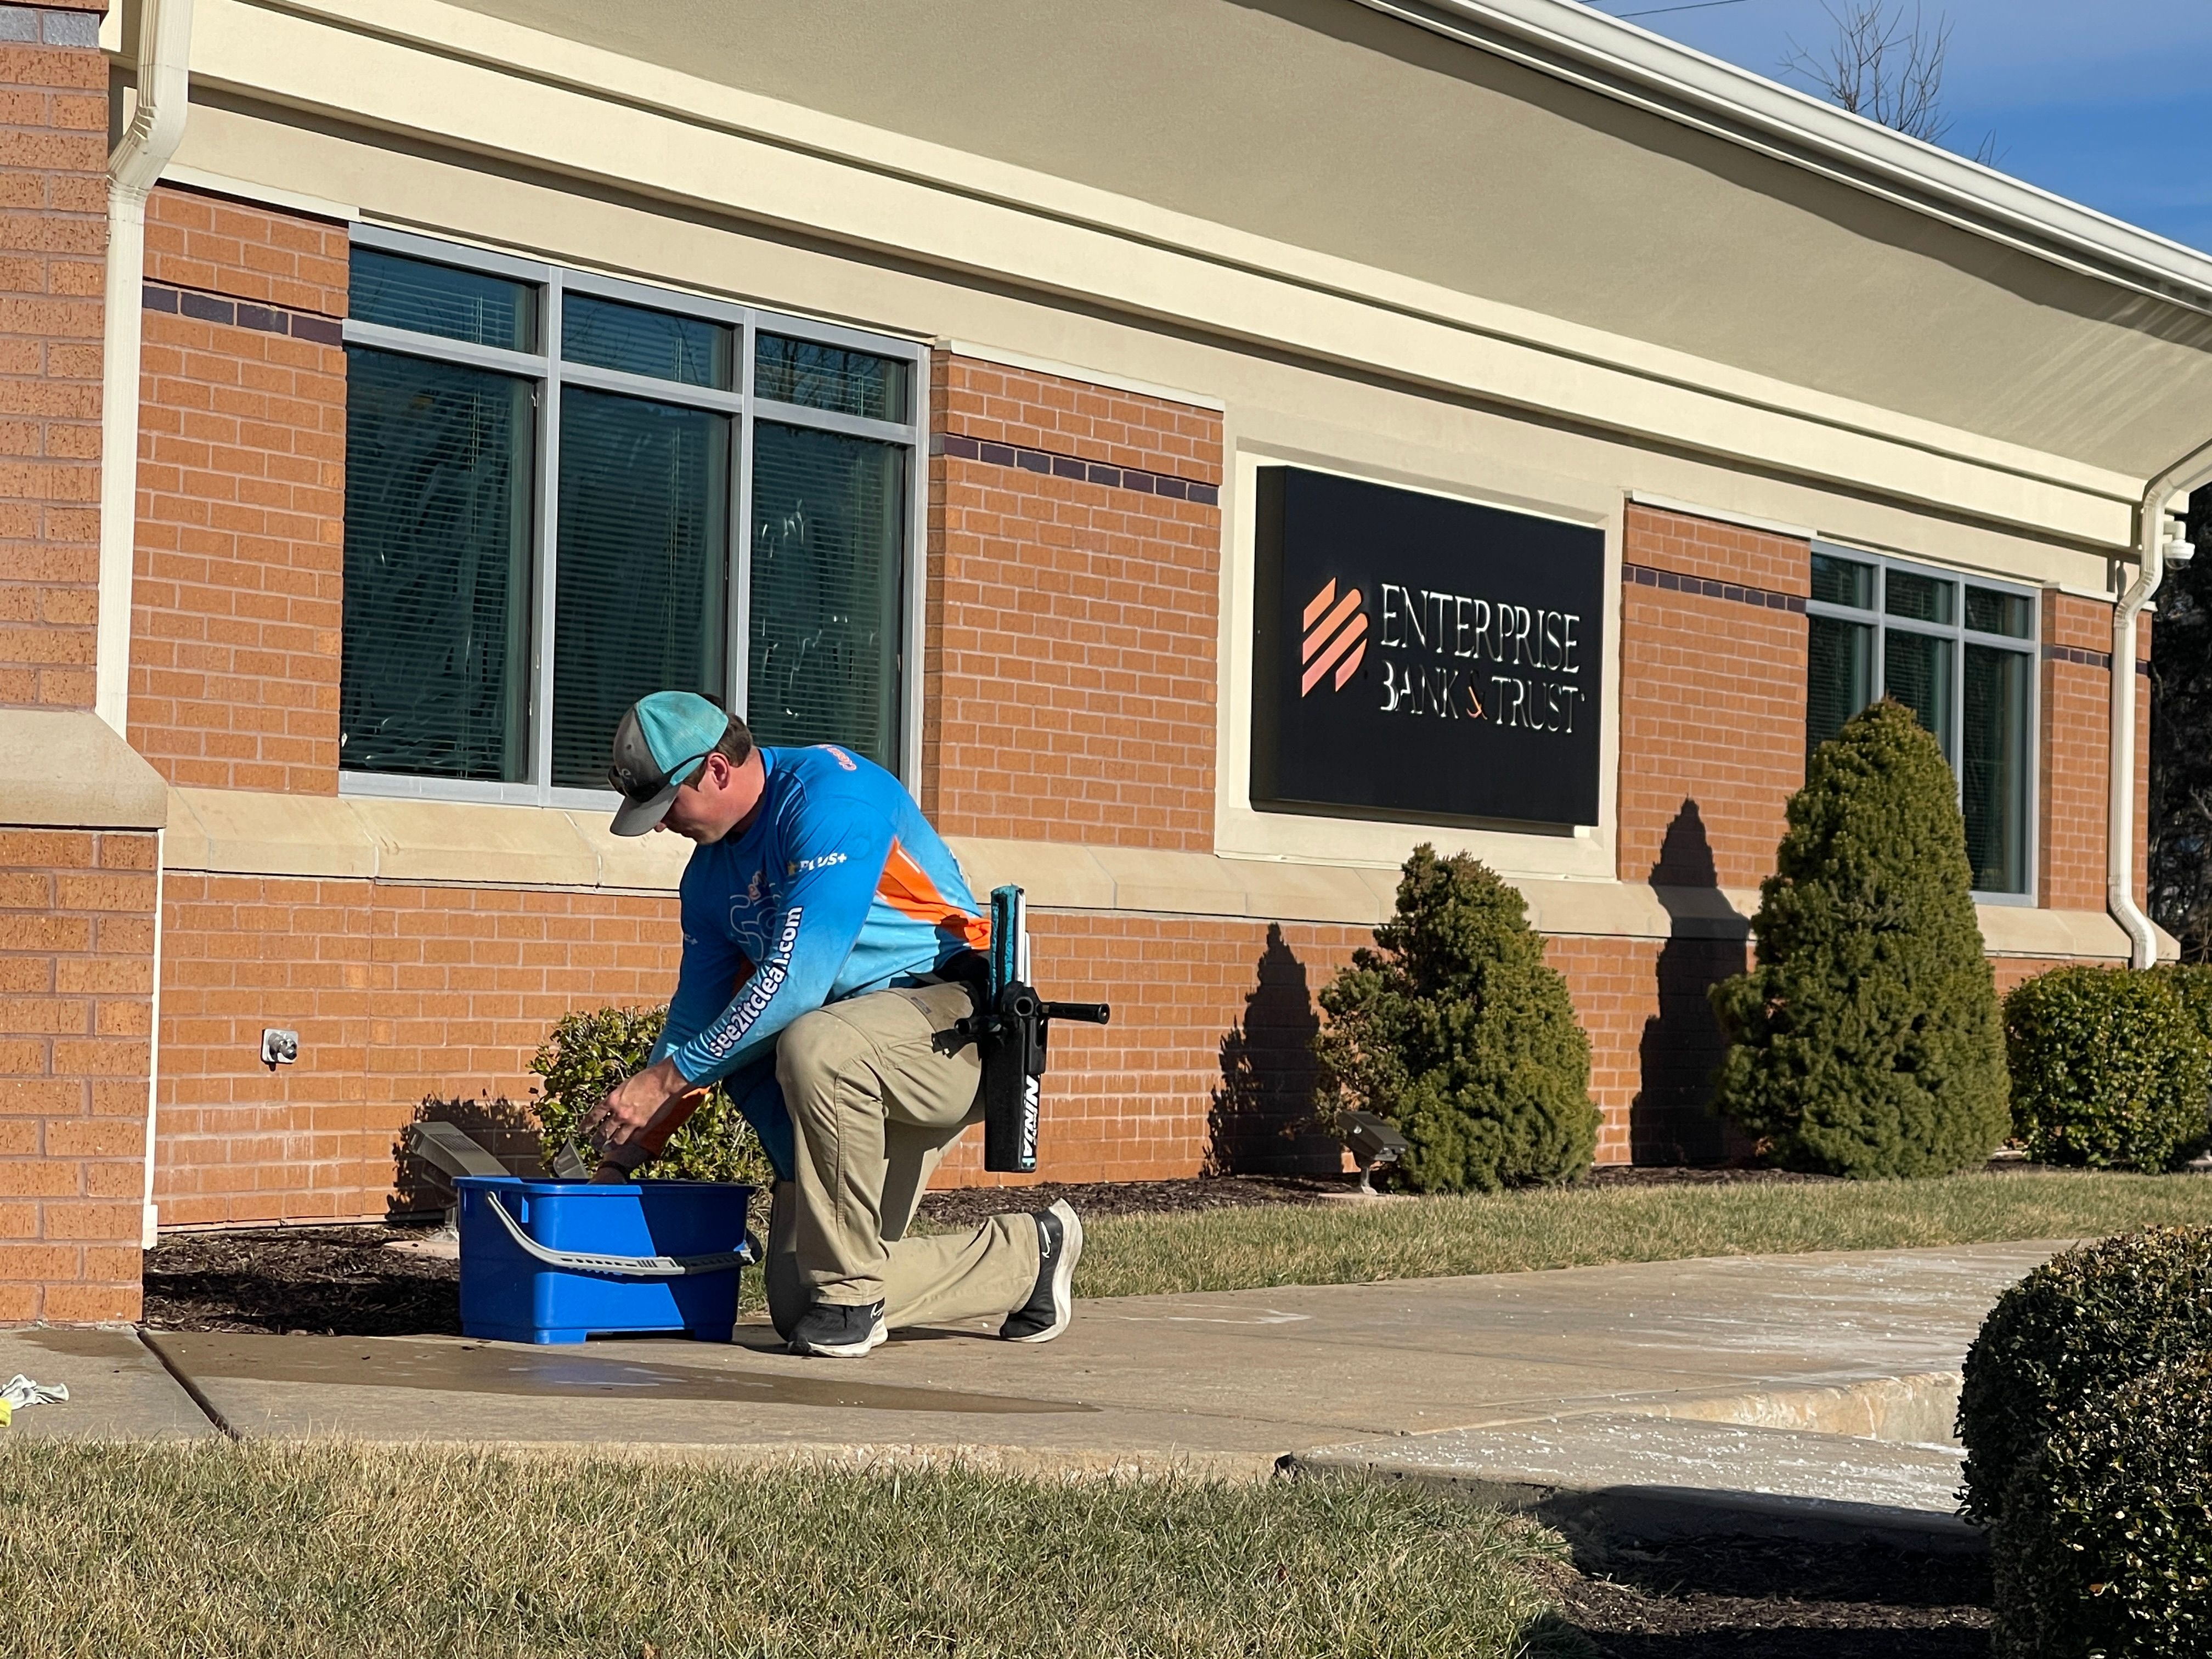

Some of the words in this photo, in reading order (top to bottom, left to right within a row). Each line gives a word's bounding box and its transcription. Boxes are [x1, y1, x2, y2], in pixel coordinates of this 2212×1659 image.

[1380, 583, 1580, 674] ENTERPRISE
[1380, 660, 1459, 720] BANK
[1466, 669, 1488, 721] &
[1023, 1074, 1039, 1157] NINJA
